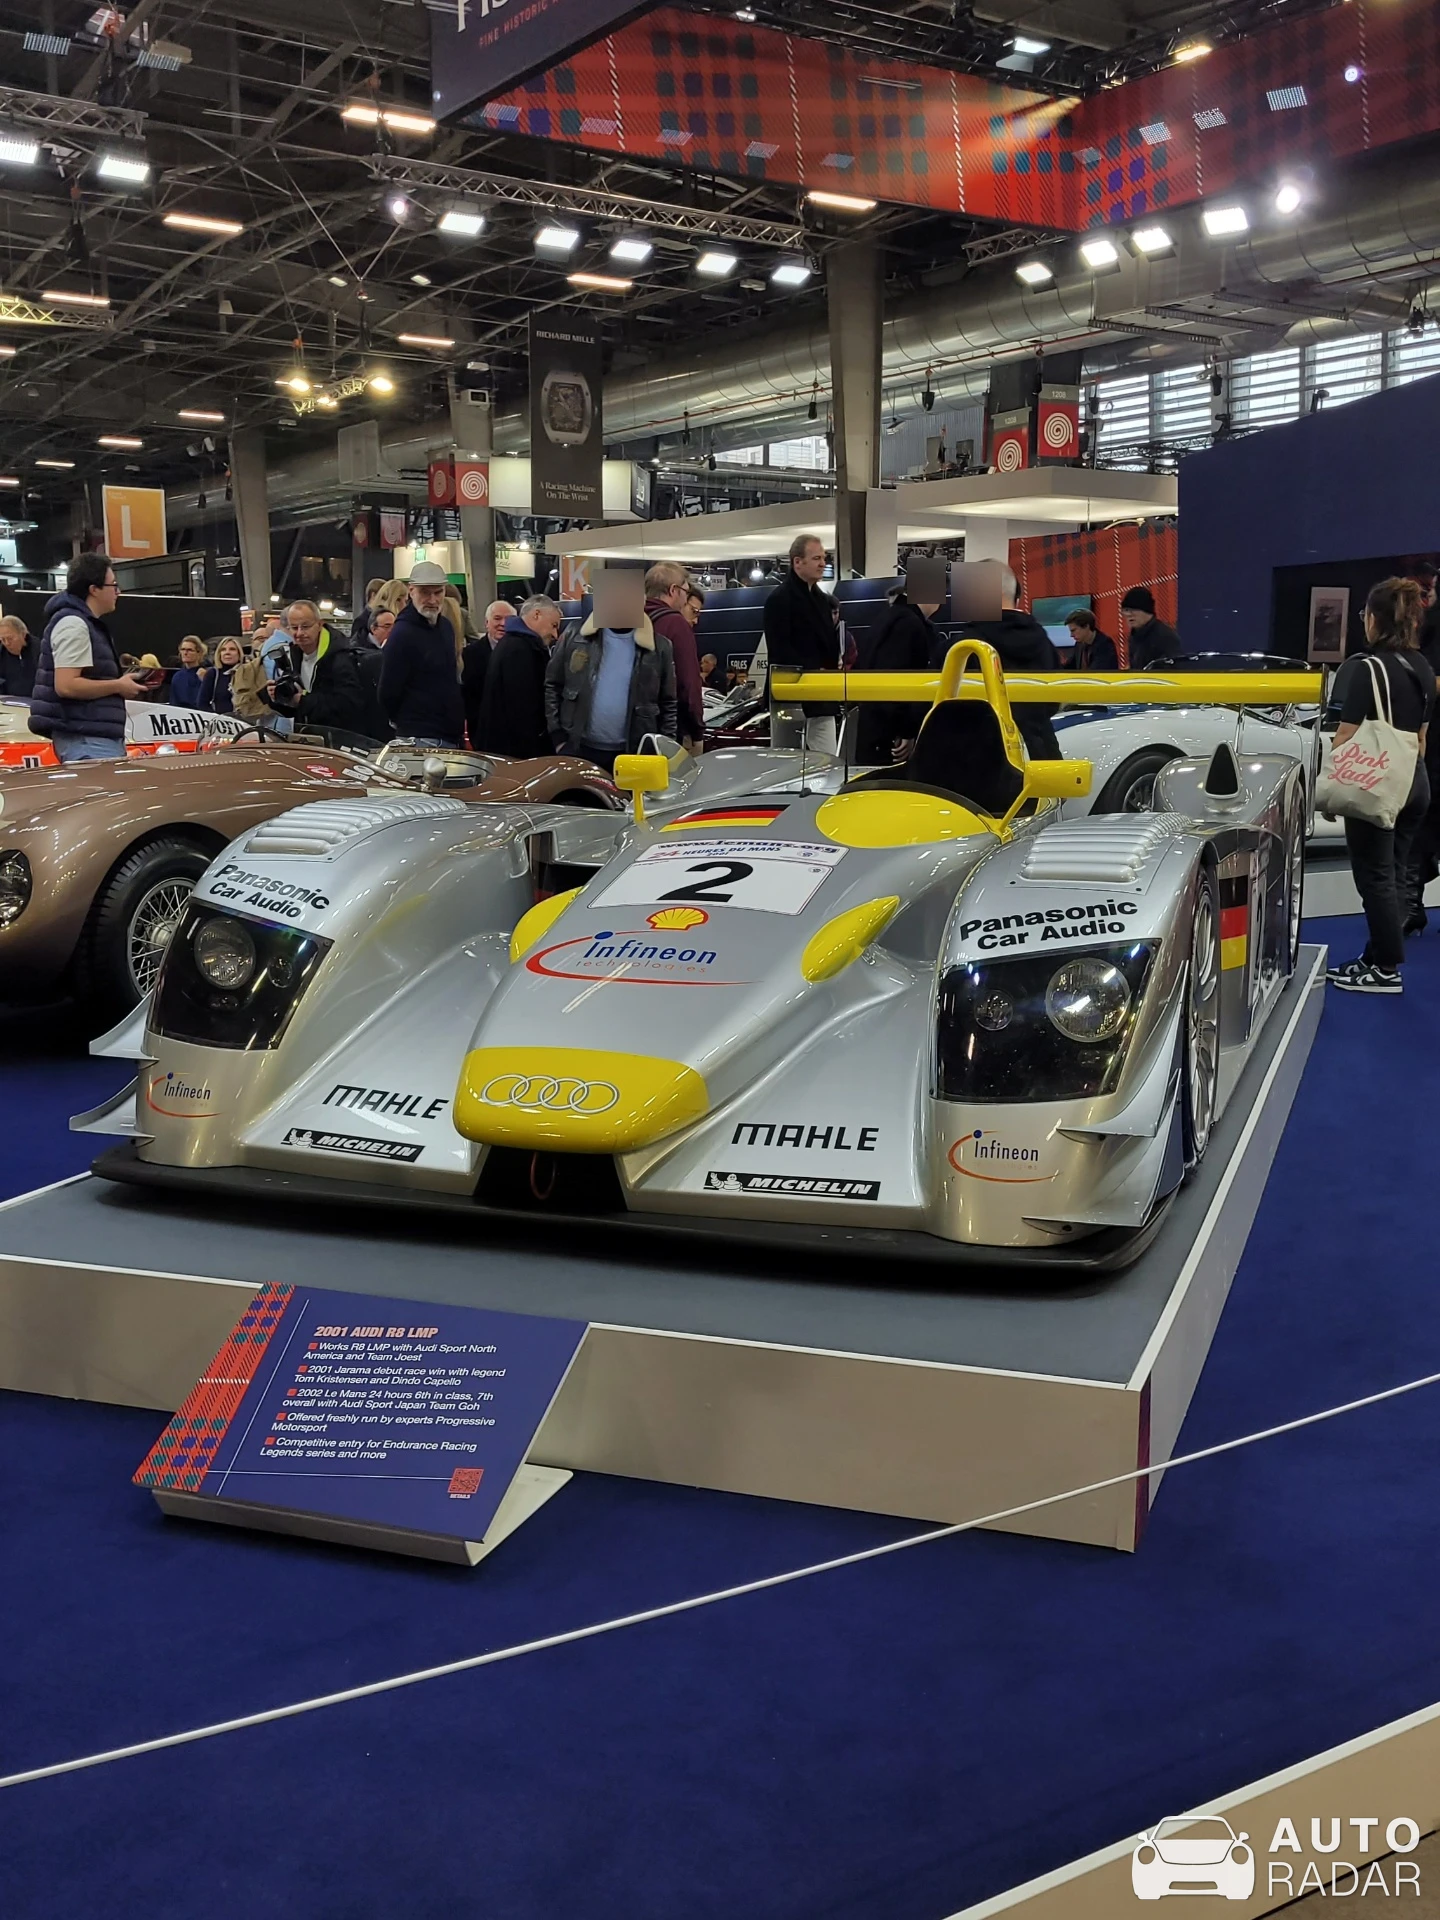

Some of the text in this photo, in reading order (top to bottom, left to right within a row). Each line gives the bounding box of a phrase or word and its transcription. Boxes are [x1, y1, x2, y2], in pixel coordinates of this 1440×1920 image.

[479, 0, 548, 48] FINE HISTORIC
[536, 330, 595, 344] RICHARD MILLE
[545, 481, 568, 492] Racing
[569, 483, 597, 493] Machine
[546, 491, 557, 499] On
[571, 493, 589, 501] Wrist
[121, 505, 150, 549] L
[568, 558, 590, 592] K
[149, 713, 244, 737] Marlboro
[1333, 743, 1390, 769] Pink
[1328, 761, 1384, 791] Lady
[648, 850, 680, 859] 24
[213, 864, 330, 909] Panasonic
[656, 861, 753, 903] 2
[209, 882, 302, 918] Car Audio
[960, 899, 1139, 942] Panasonic
[977, 919, 1126, 950] Car Audio
[583, 932, 717, 965] Infineon
[164, 1073, 211, 1100] Infineon
[322, 1084, 449, 1120] MAHLE
[316, 1135, 417, 1157] MICHELIN
[731, 1123, 880, 1152] MAHLE
[974, 1130, 1039, 1162] Infineon
[747, 1177, 873, 1195] MICHELIN
[314, 1326, 438, 1338] 2001 AUDI R8 LMP
[303, 1352, 422, 1362] America and Team Joest
[319, 1342, 349, 1350] Works
[367, 1343, 390, 1351] LMP
[392, 1343, 411, 1351] with
[413, 1344, 437, 1352] Audi
[439, 1344, 466, 1354] Sport
[468, 1345, 497, 1353] North
[308, 1365, 333, 1373] 2001
[334, 1366, 371, 1374] Jarama
[373, 1366, 402, 1375] debut
[429, 1368, 446, 1376] win
[448, 1367, 469, 1376] with
[471, 1368, 506, 1378] legend
[316, 1375, 368, 1384] Kristensen
[370, 1376, 389, 1384] and
[391, 1376, 421, 1385] Dindo
[423, 1377, 462, 1387] Capello
[282, 1399, 480, 1411] overall with Audi Sport Japan Team Goh
[297, 1389, 494, 1401] 2002 Le Mans 24 hours 6th in class, 7th
[271, 1423, 327, 1433] Motorsport
[287, 1413, 495, 1427] Offered freshly run by experts Progressive
[260, 1447, 387, 1459] Legends series and more
[276, 1437, 477, 1452] Competitive entry for Endurance Racing
